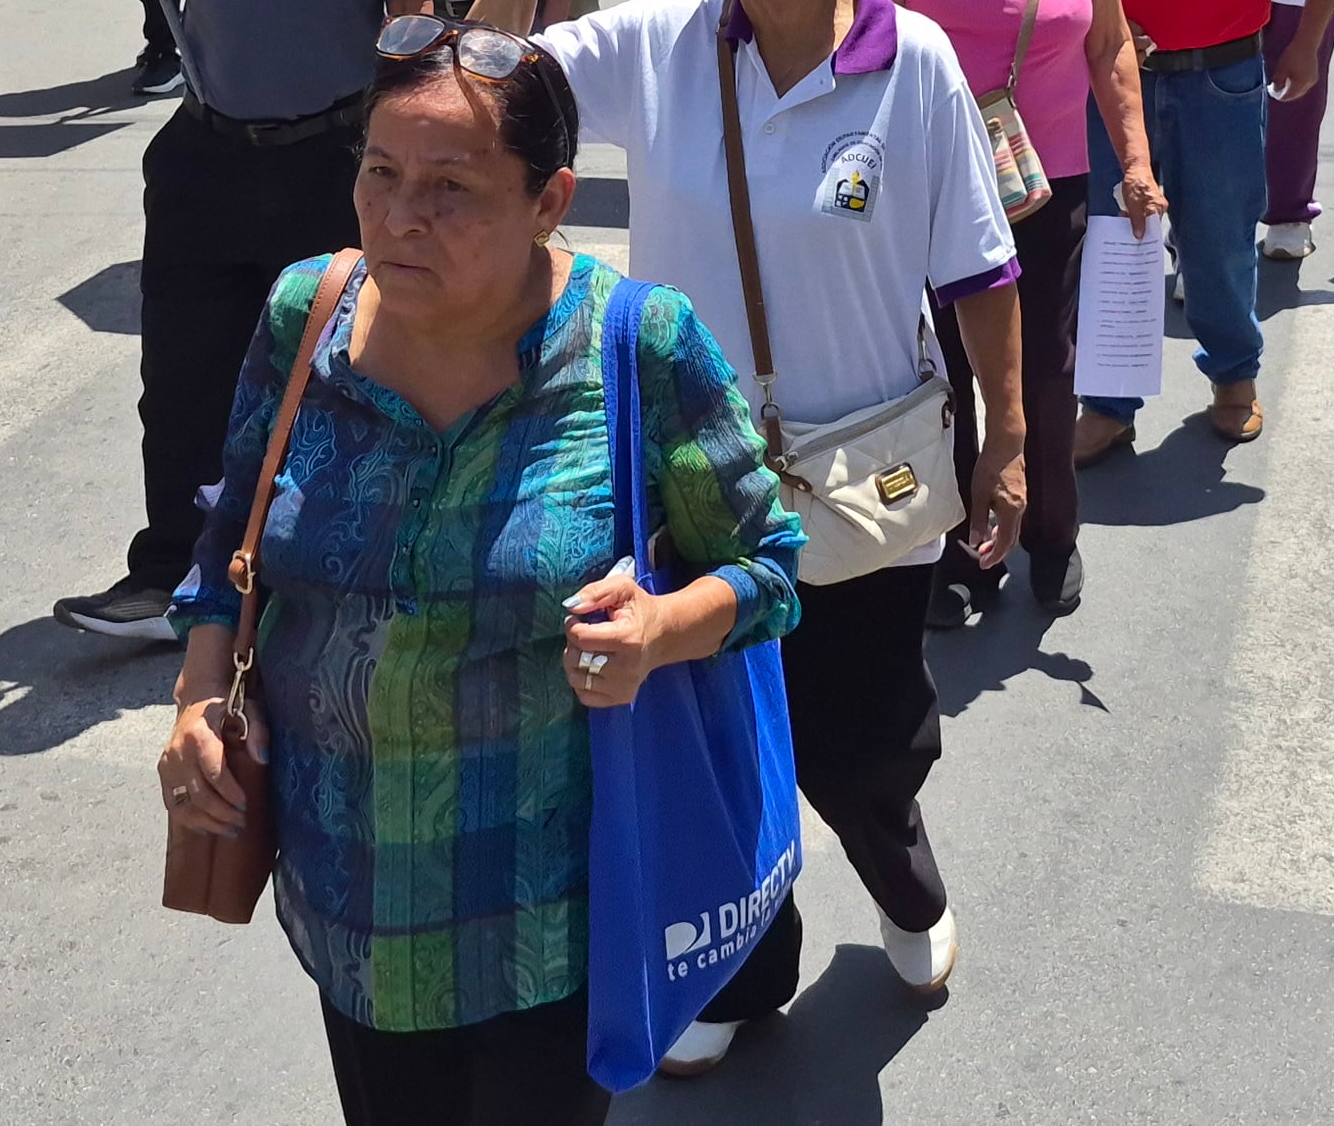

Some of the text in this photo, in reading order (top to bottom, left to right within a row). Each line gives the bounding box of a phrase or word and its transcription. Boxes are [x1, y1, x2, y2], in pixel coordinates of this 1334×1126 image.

[719, 839, 795, 939] DIRECTV
[667, 960, 689, 981] te
[697, 925, 757, 970] cambia
